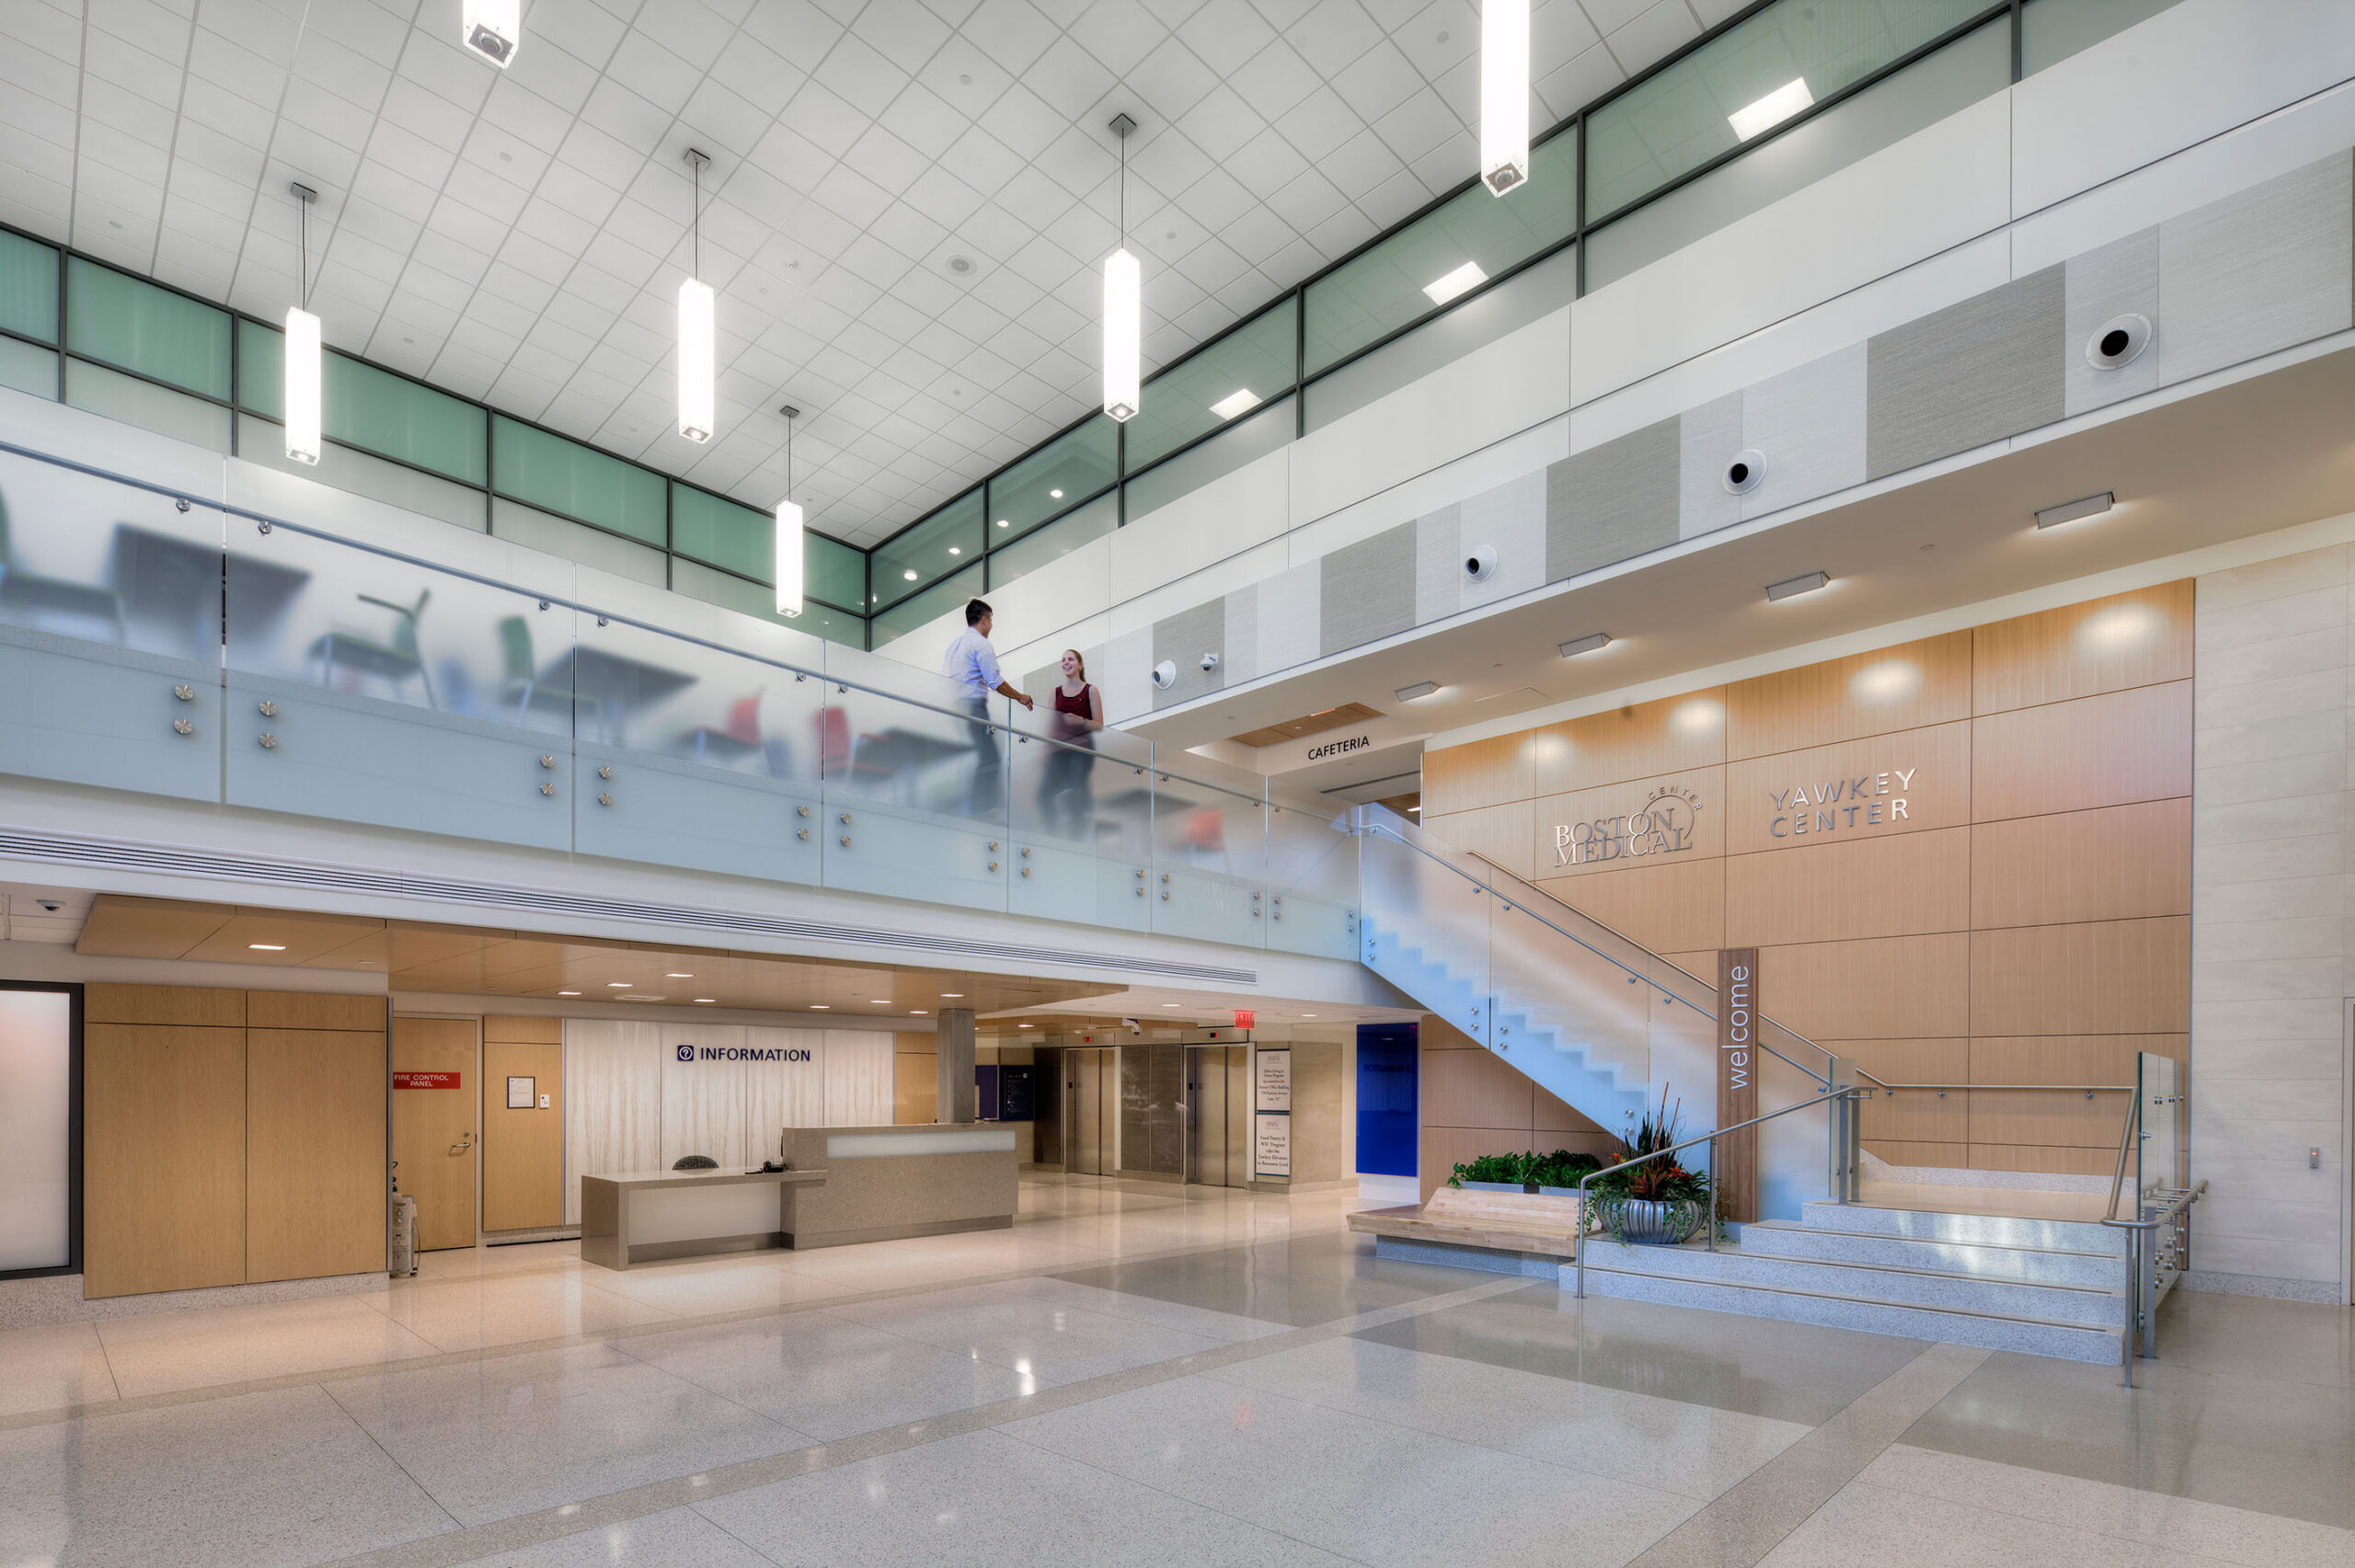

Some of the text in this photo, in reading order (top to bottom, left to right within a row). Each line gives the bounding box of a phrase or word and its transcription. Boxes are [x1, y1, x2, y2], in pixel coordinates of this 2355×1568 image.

[1307, 736, 1370, 761] CAFETERIA
[1648, 785, 1703, 811] CENTER
[1770, 768, 1918, 811] YAWKEY
[1554, 807, 1675, 848] BOSTON
[1769, 798, 1910, 838] CENTER
[1553, 828, 1693, 868] MEDICAL
[1237, 1013, 1254, 1027] EXIT
[1721, 966, 1749, 1090] welcome
[700, 1047, 810, 1062] INFORMATION
